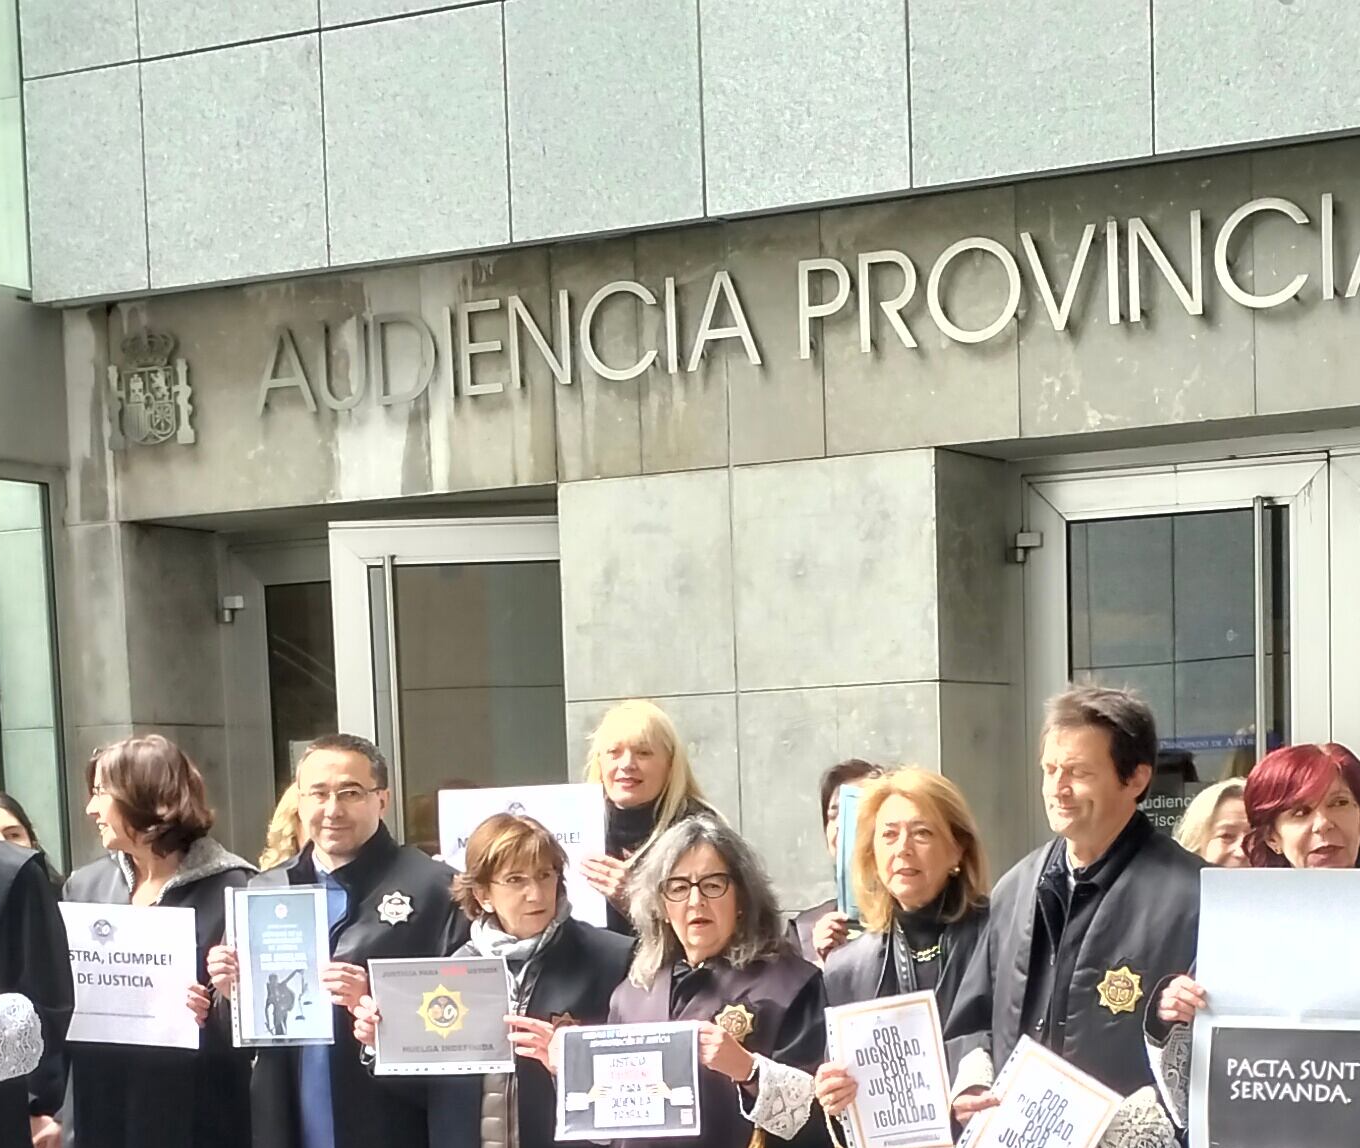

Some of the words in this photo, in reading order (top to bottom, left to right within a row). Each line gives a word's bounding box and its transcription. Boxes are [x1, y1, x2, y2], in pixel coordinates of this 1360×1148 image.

[256, 270, 762, 417] AUDIENCIA
[1224, 737, 1255, 747] ASTUR
[1137, 795, 1194, 810] udienc
[69, 950, 104, 965] STRA,
[108, 951, 172, 966] ¡CUMPLE!
[77, 972, 94, 985] DE
[98, 973, 154, 988] JUSTICIA
[872, 1025, 901, 1046] POR
[855, 1038, 926, 1067] DIGNIDAD,
[880, 1057, 909, 1077] POR
[1227, 1058, 1295, 1080] PACTA
[1299, 1059, 1360, 1081] SUNT
[868, 1071, 931, 1096] JUSTICIA,
[1230, 1080, 1352, 1104] SERVANDA.
[889, 1089, 916, 1109] POR
[1040, 1088, 1069, 1116] POR
[873, 1103, 936, 1128] IGUALDAD
[1022, 1120, 1051, 1147] POR
